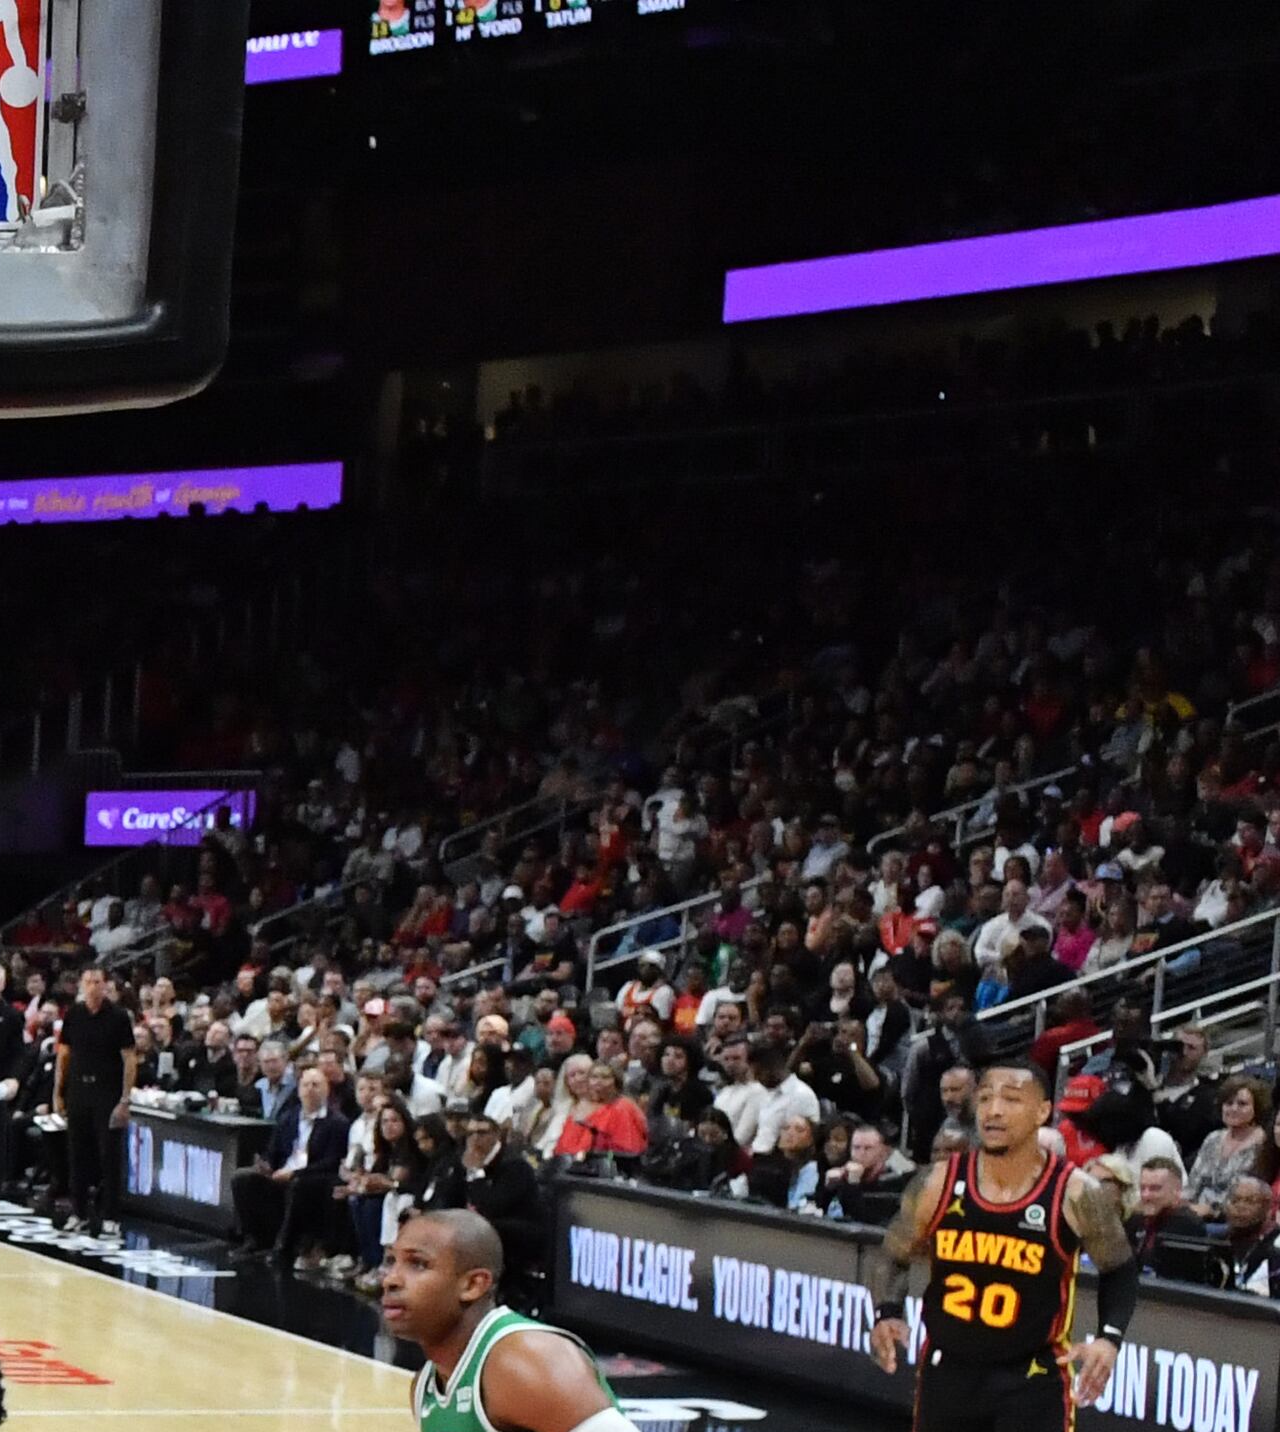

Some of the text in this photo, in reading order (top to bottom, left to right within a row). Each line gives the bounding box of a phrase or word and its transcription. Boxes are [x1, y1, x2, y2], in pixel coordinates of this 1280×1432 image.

[570, 1225, 619, 1294] YOUR
[621, 1237, 698, 1312] LEAGUE.
[713, 1255, 770, 1330] YOUR
[936, 1229, 1045, 1274] HAWKS
[943, 1272, 1020, 1328] 20
